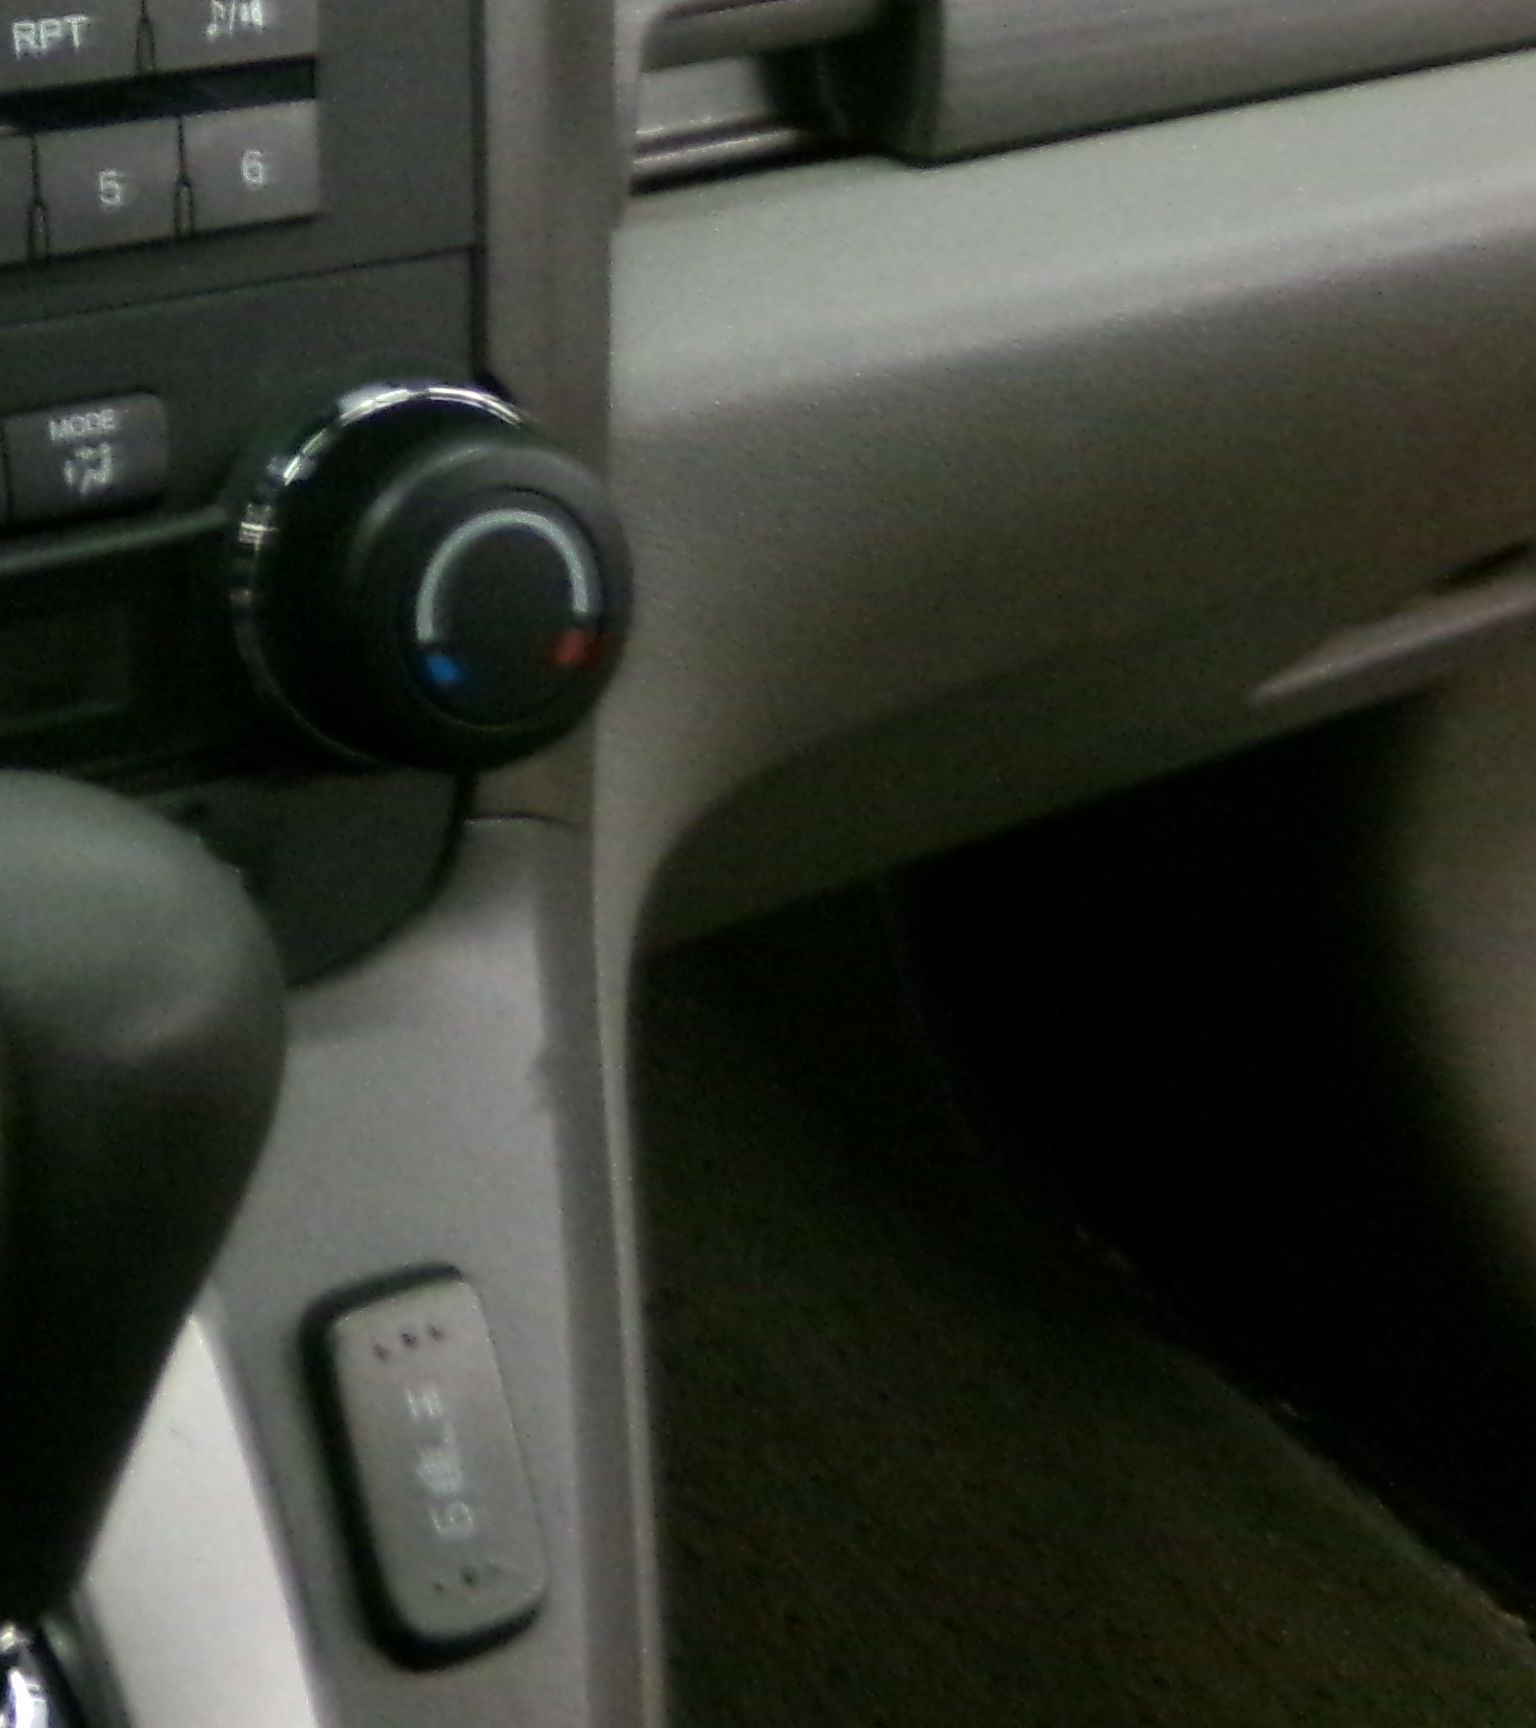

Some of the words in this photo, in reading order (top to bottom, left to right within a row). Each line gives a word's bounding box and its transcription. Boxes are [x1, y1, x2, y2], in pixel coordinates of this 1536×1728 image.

[12, 13, 91, 59] RPT
[240, 149, 266, 188] 6
[96, 170, 124, 210] 5
[48, 408, 117, 443] MODE
